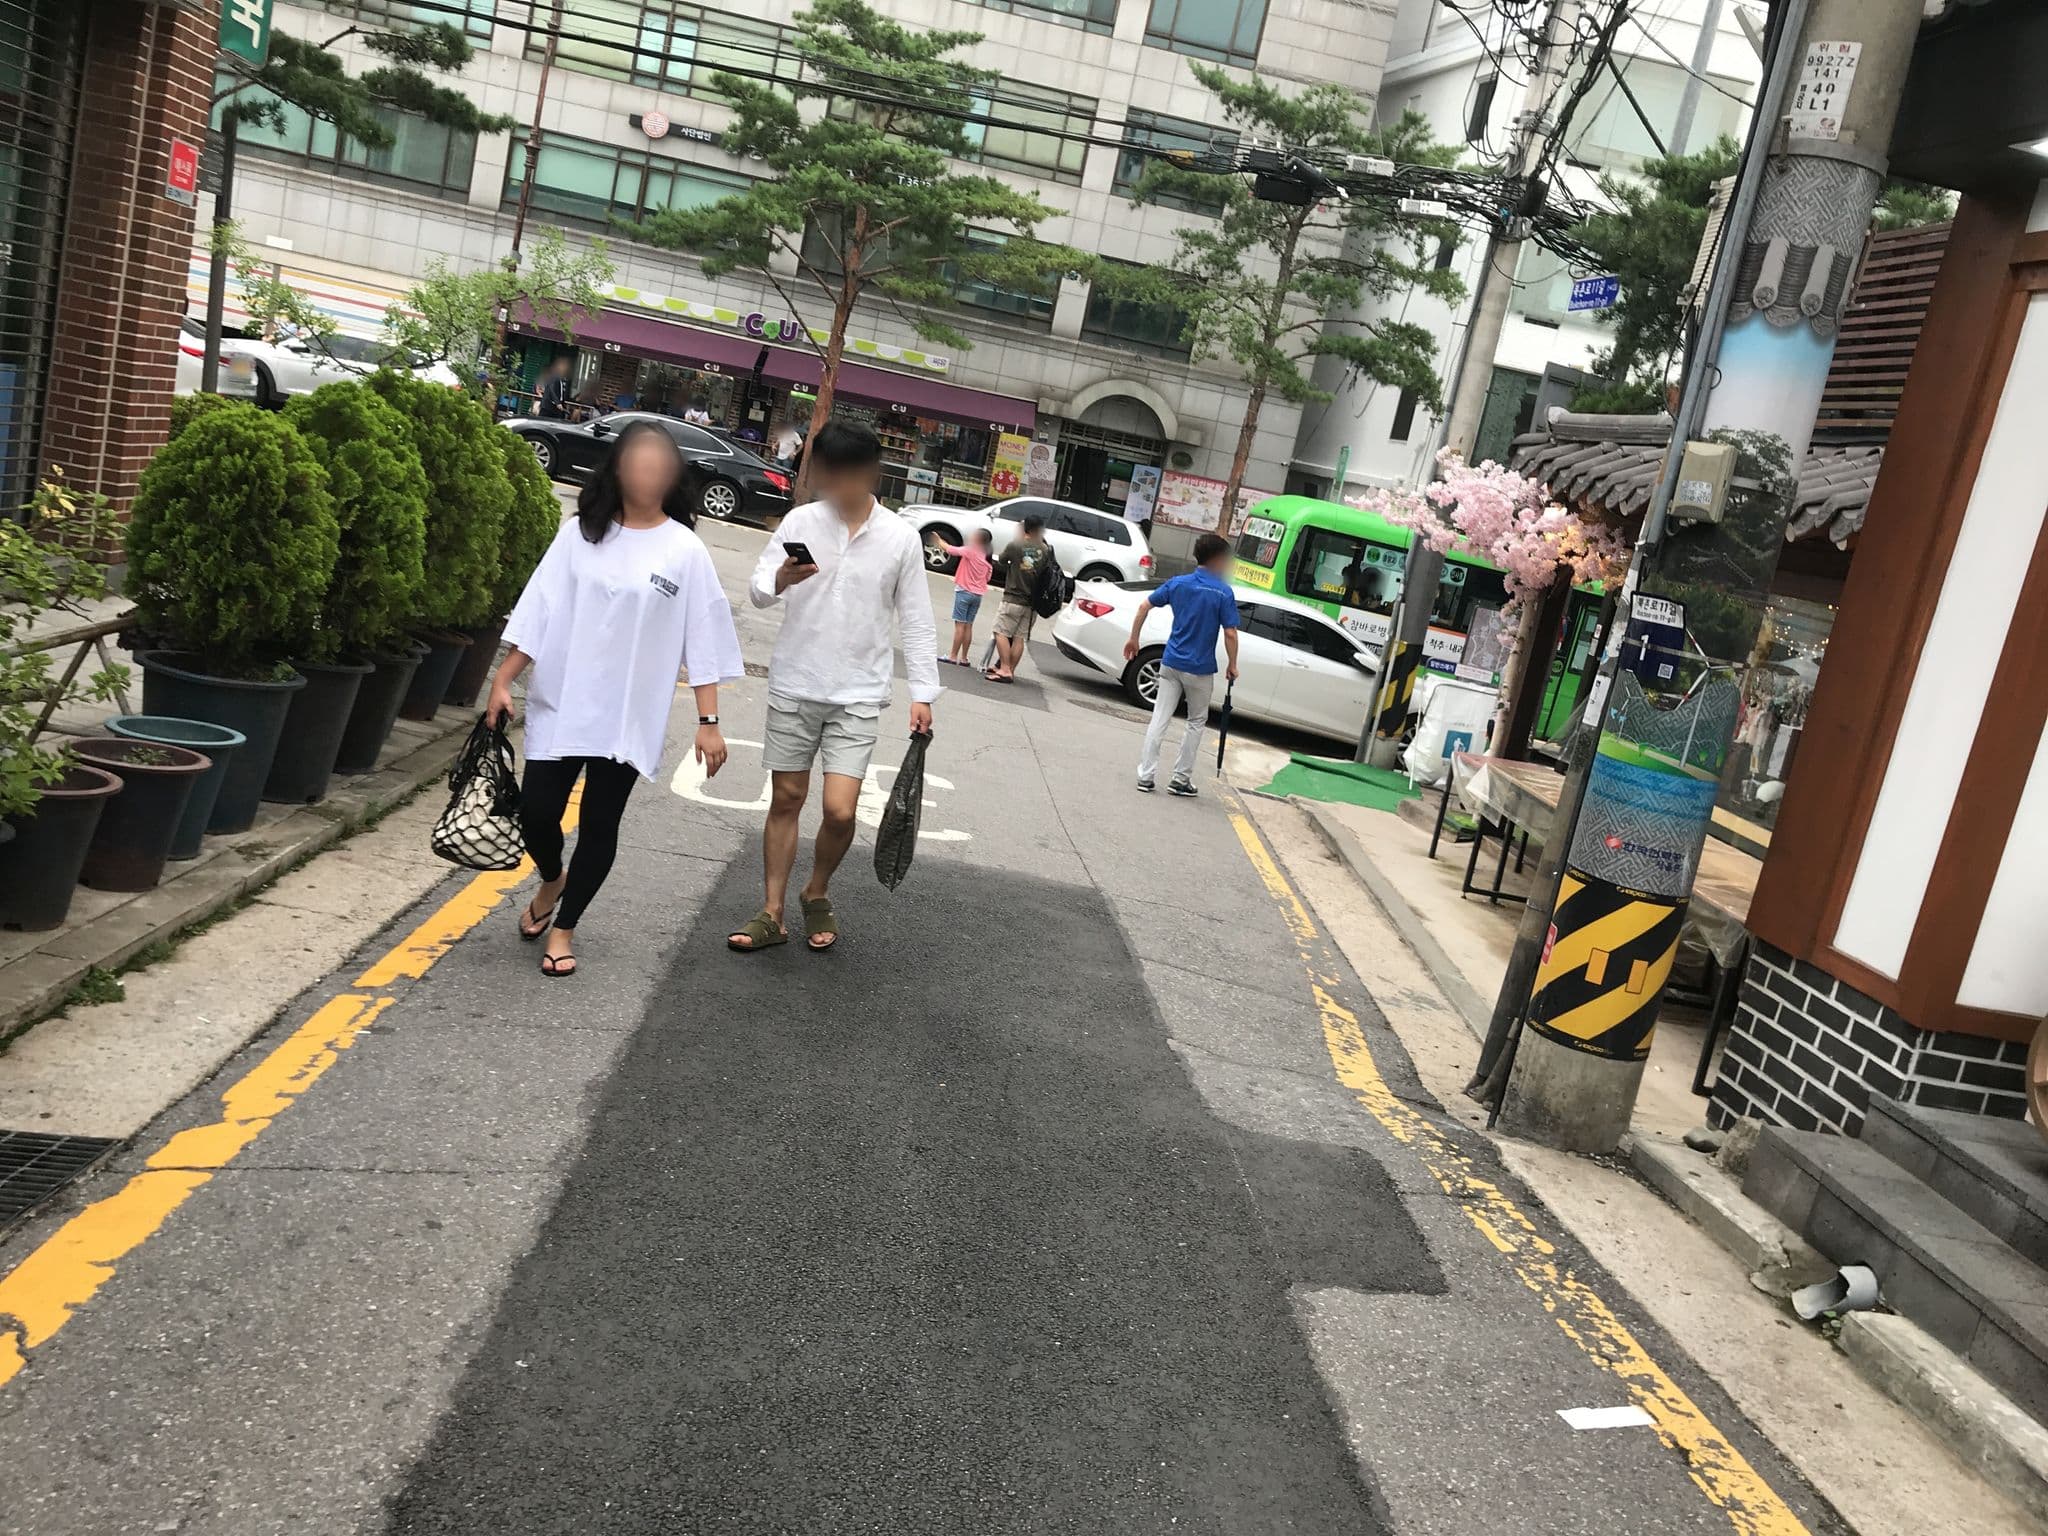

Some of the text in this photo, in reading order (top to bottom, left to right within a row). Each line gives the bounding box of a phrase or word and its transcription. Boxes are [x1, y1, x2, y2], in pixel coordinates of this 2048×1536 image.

[1807, 55, 1855, 68] 9927Z
[1814, 68, 1840, 78] 141
[1813, 82, 1835, 95] 40
[1809, 98, 1829, 111] L1
[744, 312, 799, 343] CU
[604, 342, 621, 352] CU
[704, 362, 720, 373] CU
[793, 383, 809, 392] CU
[891, 403, 907, 413] CU
[989, 423, 1005, 432] CU
[1000, 440, 1026, 451] MONEY
